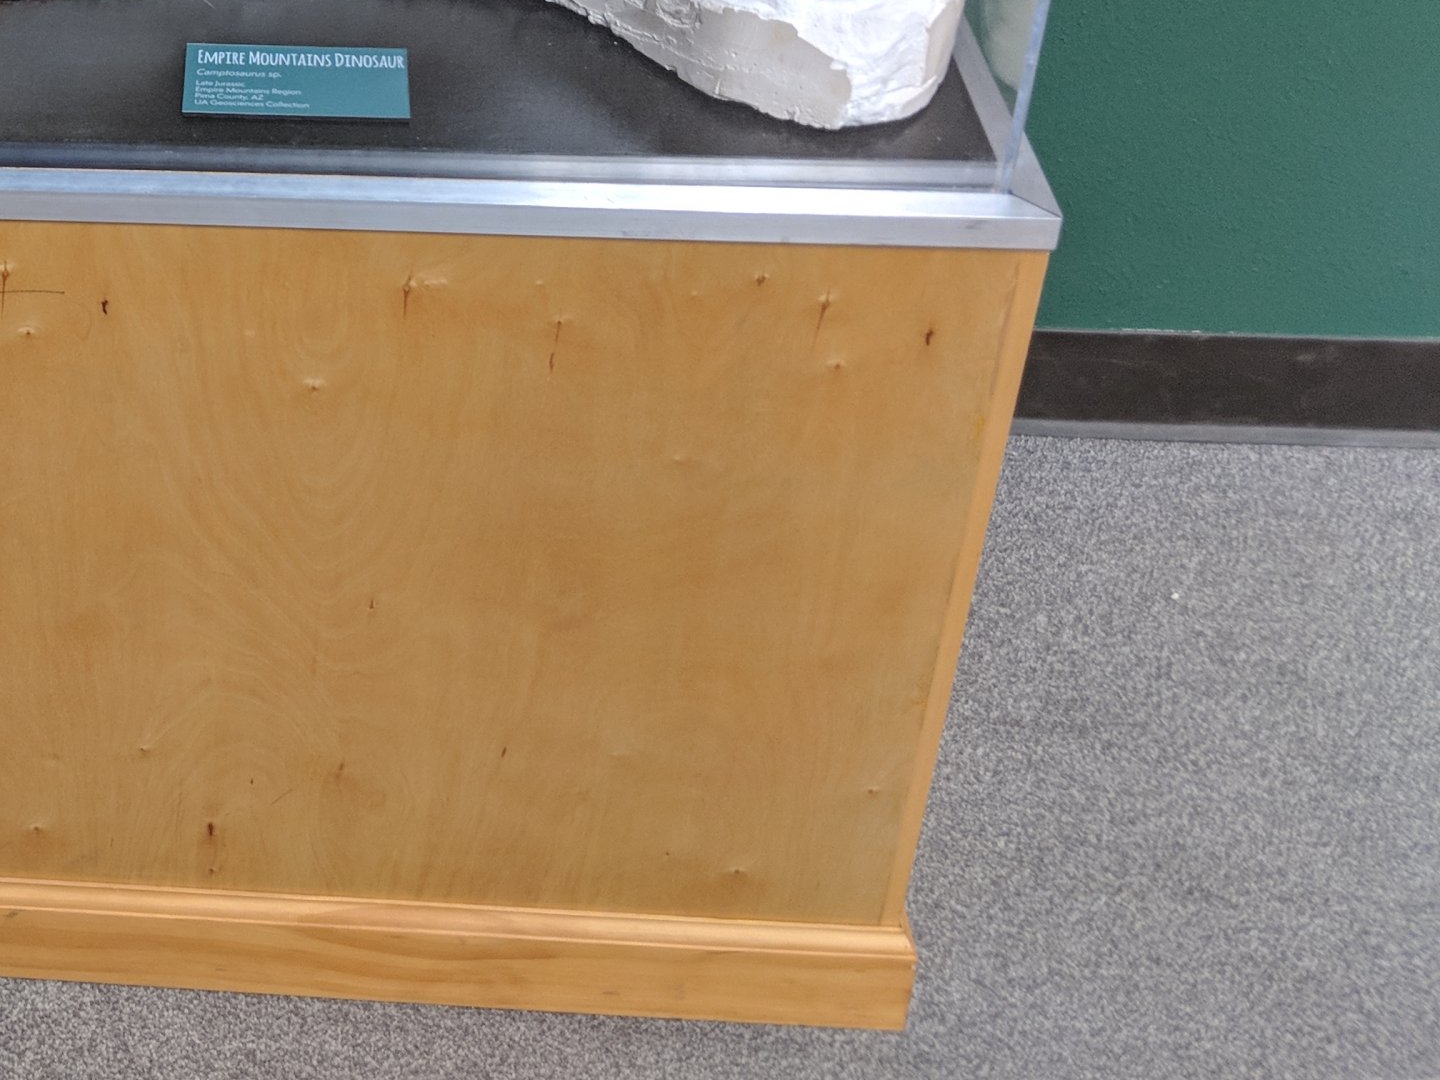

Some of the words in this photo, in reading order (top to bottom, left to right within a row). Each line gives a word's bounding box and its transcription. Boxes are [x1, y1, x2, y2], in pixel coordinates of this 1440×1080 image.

[197, 49, 246, 65] EMPIRE
[249, 51, 333, 67] MOUNTAINS
[334, 53, 406, 69] DINOSAUR
[196, 68, 266, 78] Camptosaurus
[267, 71, 283, 79] sp.
[214, 80, 246, 88] Jurassic
[195, 86, 225, 94] Empire
[225, 87, 270, 95] Mountains
[271, 88, 302, 97] Region
[194, 98, 209, 106] UA
[265, 101, 311, 109] Collection
